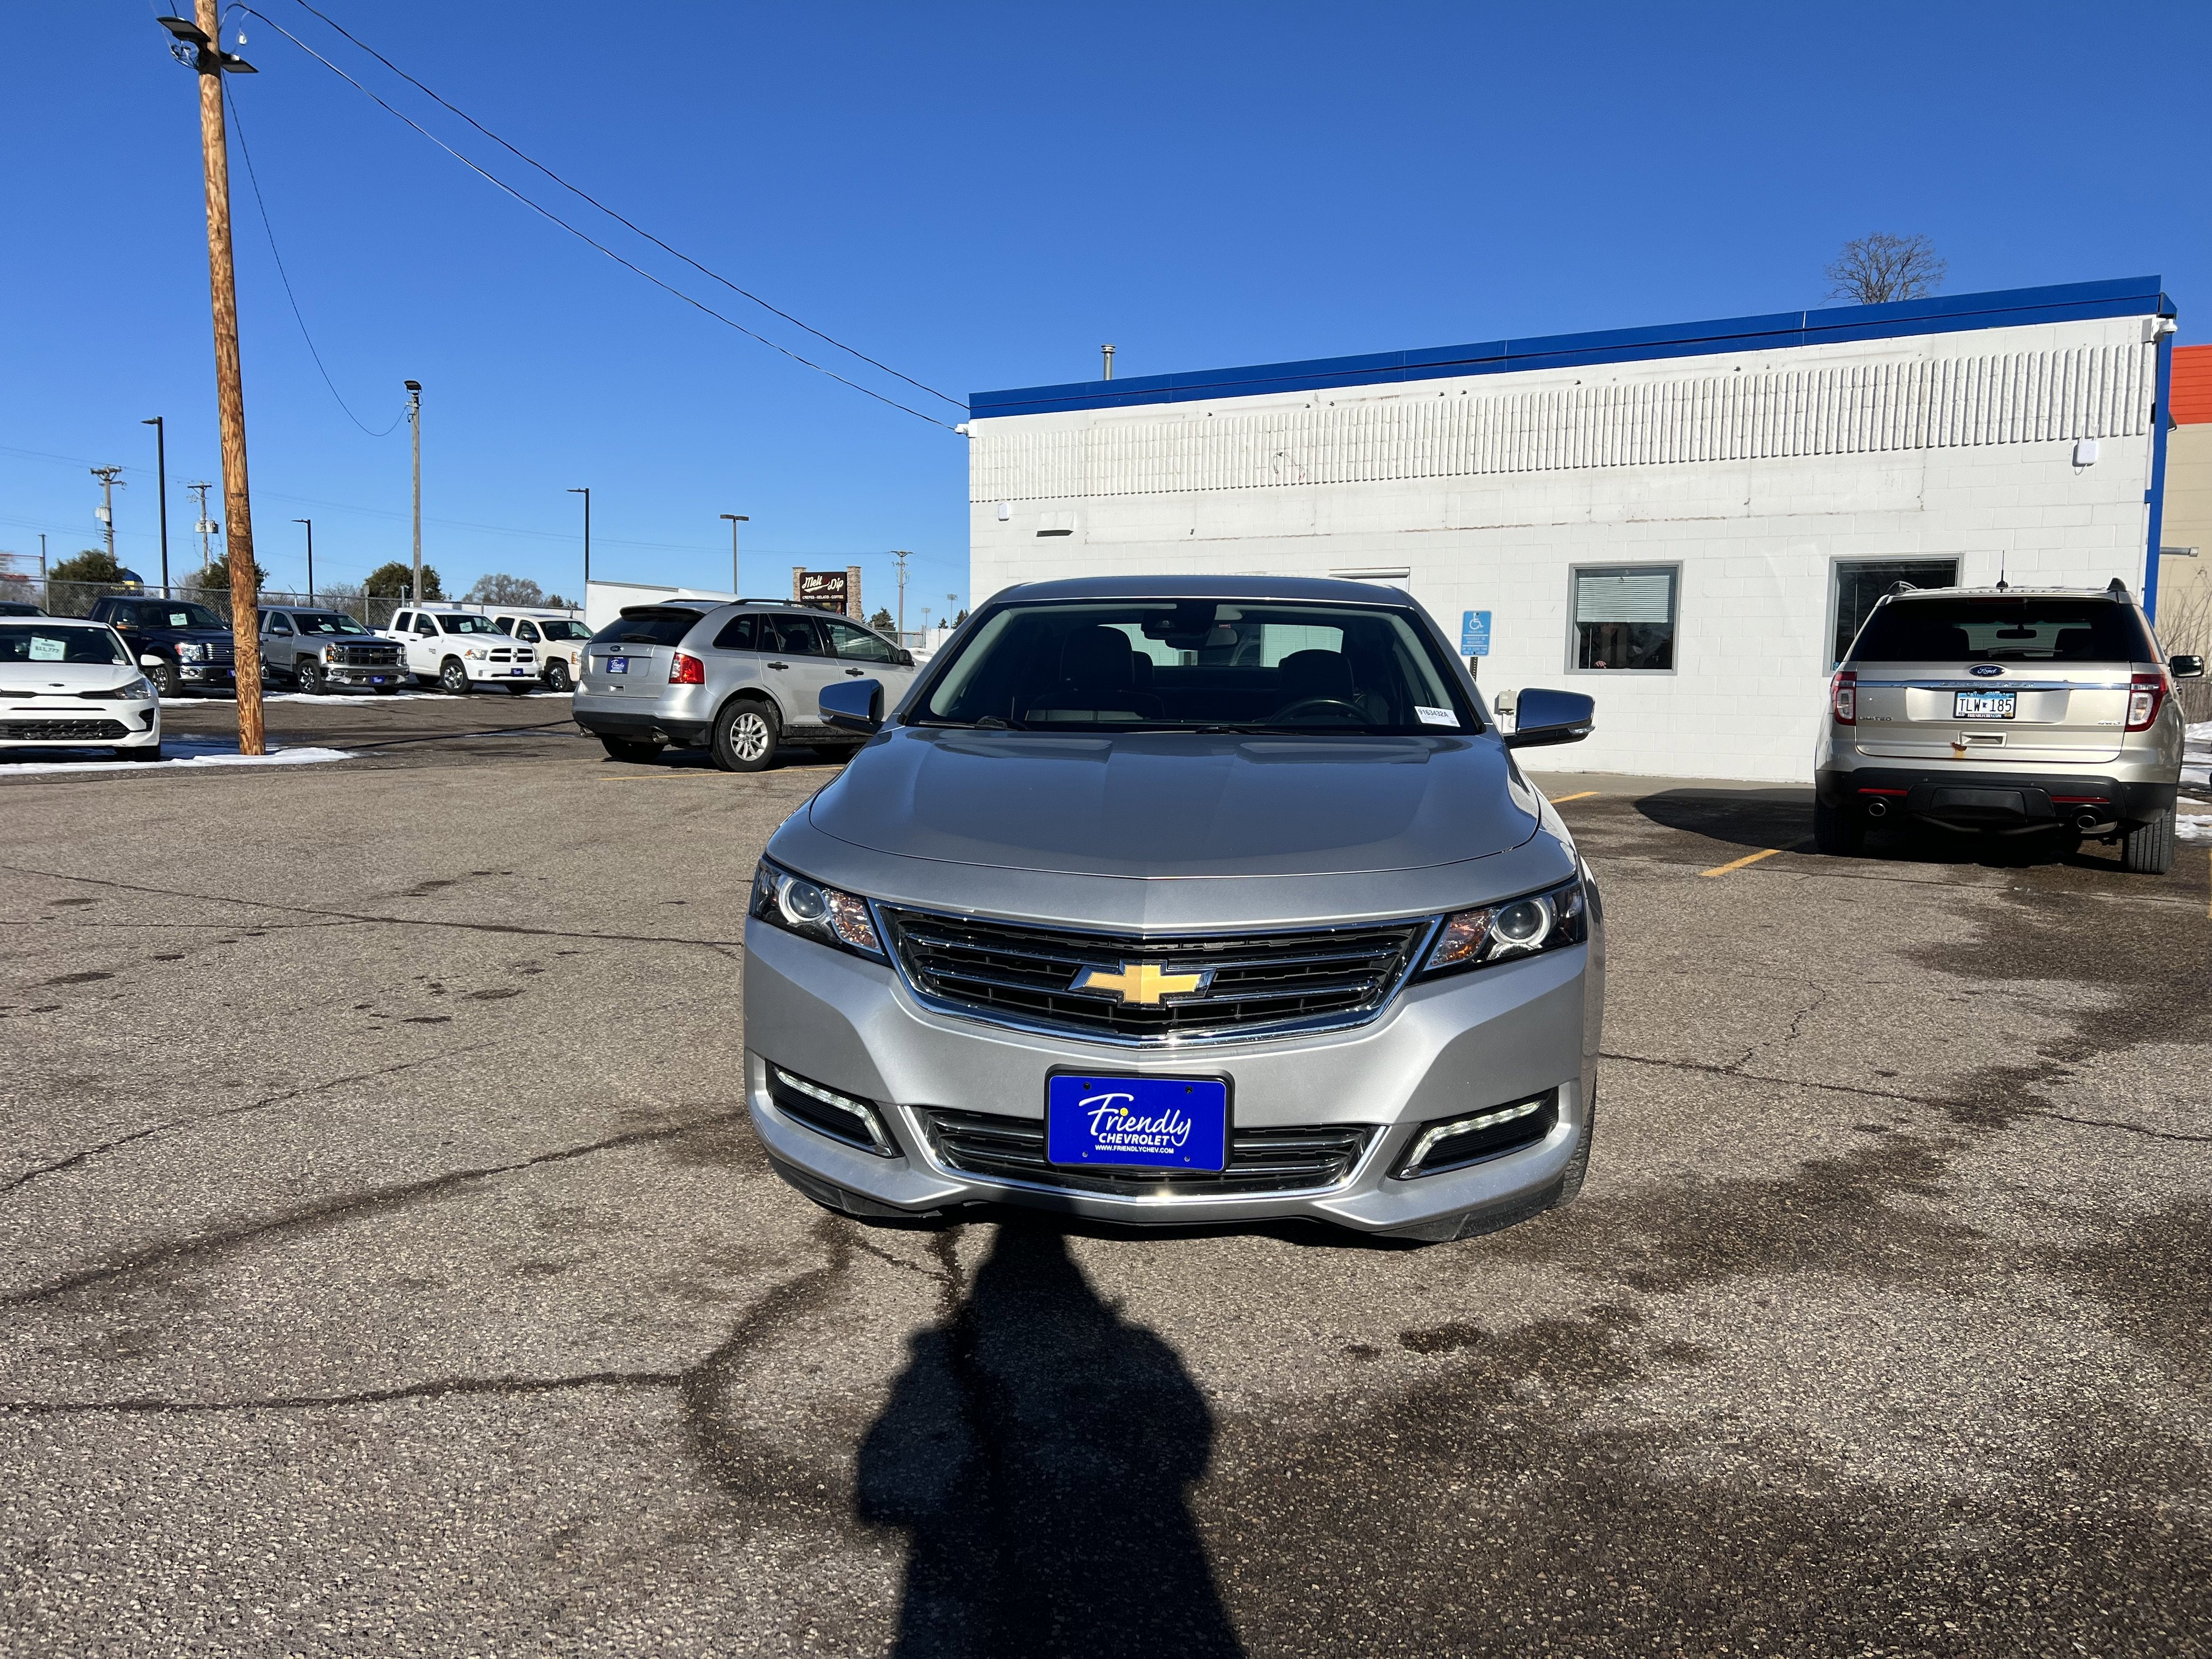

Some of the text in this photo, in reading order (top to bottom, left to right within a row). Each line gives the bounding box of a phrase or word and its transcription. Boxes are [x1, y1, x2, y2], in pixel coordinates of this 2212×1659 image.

[802, 575, 844, 591] Melt Dip
[1959, 698, 2012, 712] TLW 185
[1079, 1093, 1191, 1147] Friendly
[1098, 1132, 1170, 1146] CHEVROLET
[1095, 1144, 1175, 1154] WWW.FRIENDLYCHEV.COM
